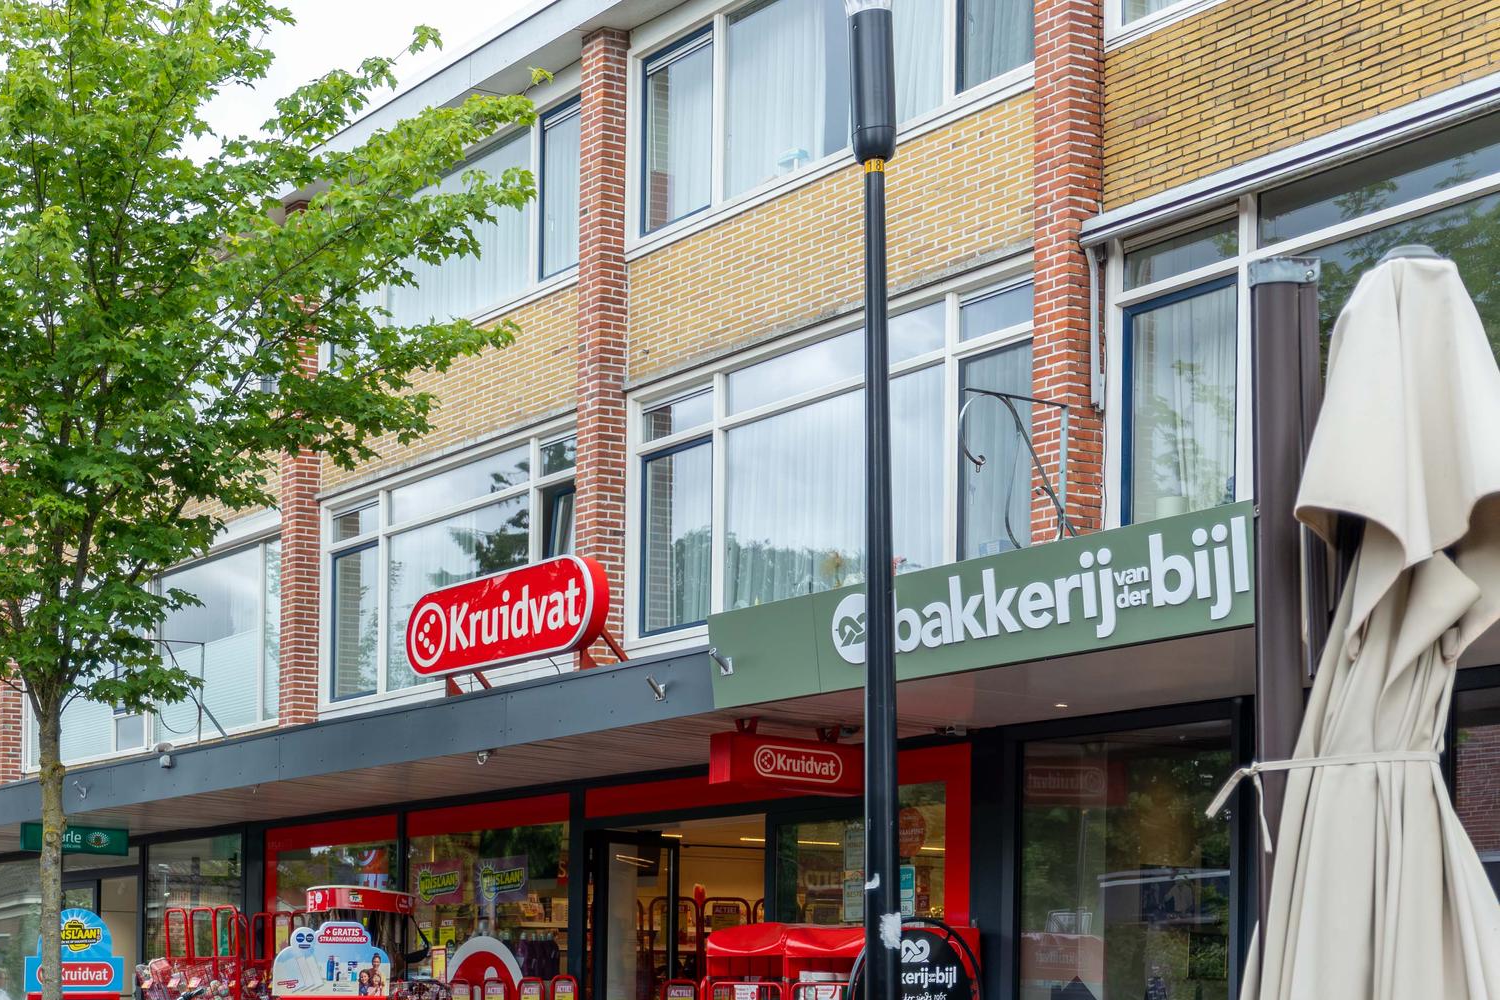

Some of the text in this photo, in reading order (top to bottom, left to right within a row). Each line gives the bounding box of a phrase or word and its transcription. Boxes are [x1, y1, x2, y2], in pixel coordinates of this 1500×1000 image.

[1113, 563, 1150, 588] van
[1149, 516, 1250, 620] bijl
[894, 548, 1117, 654] bakkerij
[1116, 586, 1150, 610] der
[449, 577, 582, 652] Kruidvat
[776, 753, 836, 776] Kruidvat
[59, 829, 82, 844] arle
[61, 928, 101, 940] NSLAAN!
[332, 928, 361, 937] GRATIS
[902, 967, 929, 989] kerij
[935, 966, 957, 989] bijl
